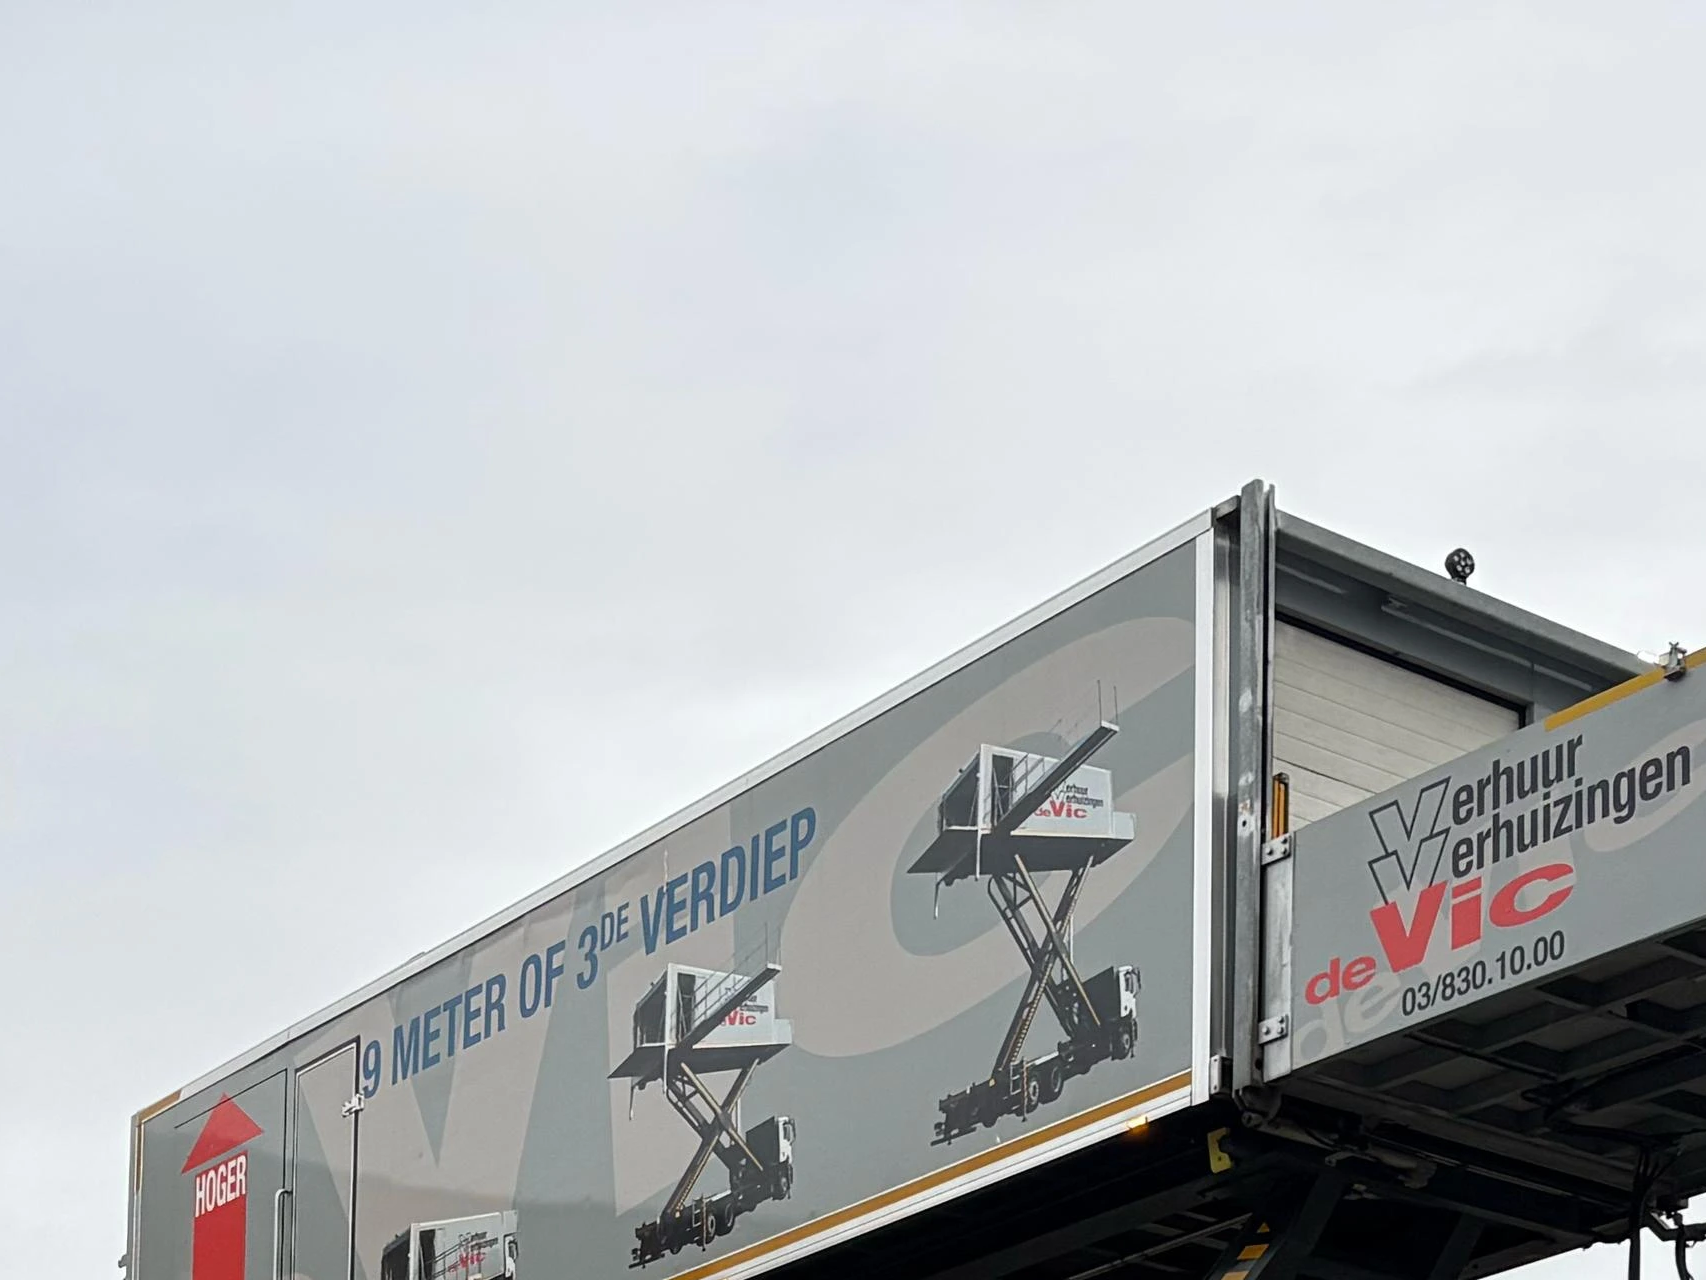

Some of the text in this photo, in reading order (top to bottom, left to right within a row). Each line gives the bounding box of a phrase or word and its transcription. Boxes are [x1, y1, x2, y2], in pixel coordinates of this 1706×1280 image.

[1368, 734, 1585, 857] Verhuur
[1368, 745, 1691, 906] Verhuizingen
[363, 1040, 381, 1099] 9
[392, 973, 507, 1086] METER
[519, 940, 566, 1019] OF
[640, 807, 817, 956] VERDIEP
[1401, 930, 1566, 1017] 03/830.10.00
[195, 1154, 248, 1218] HOGER
